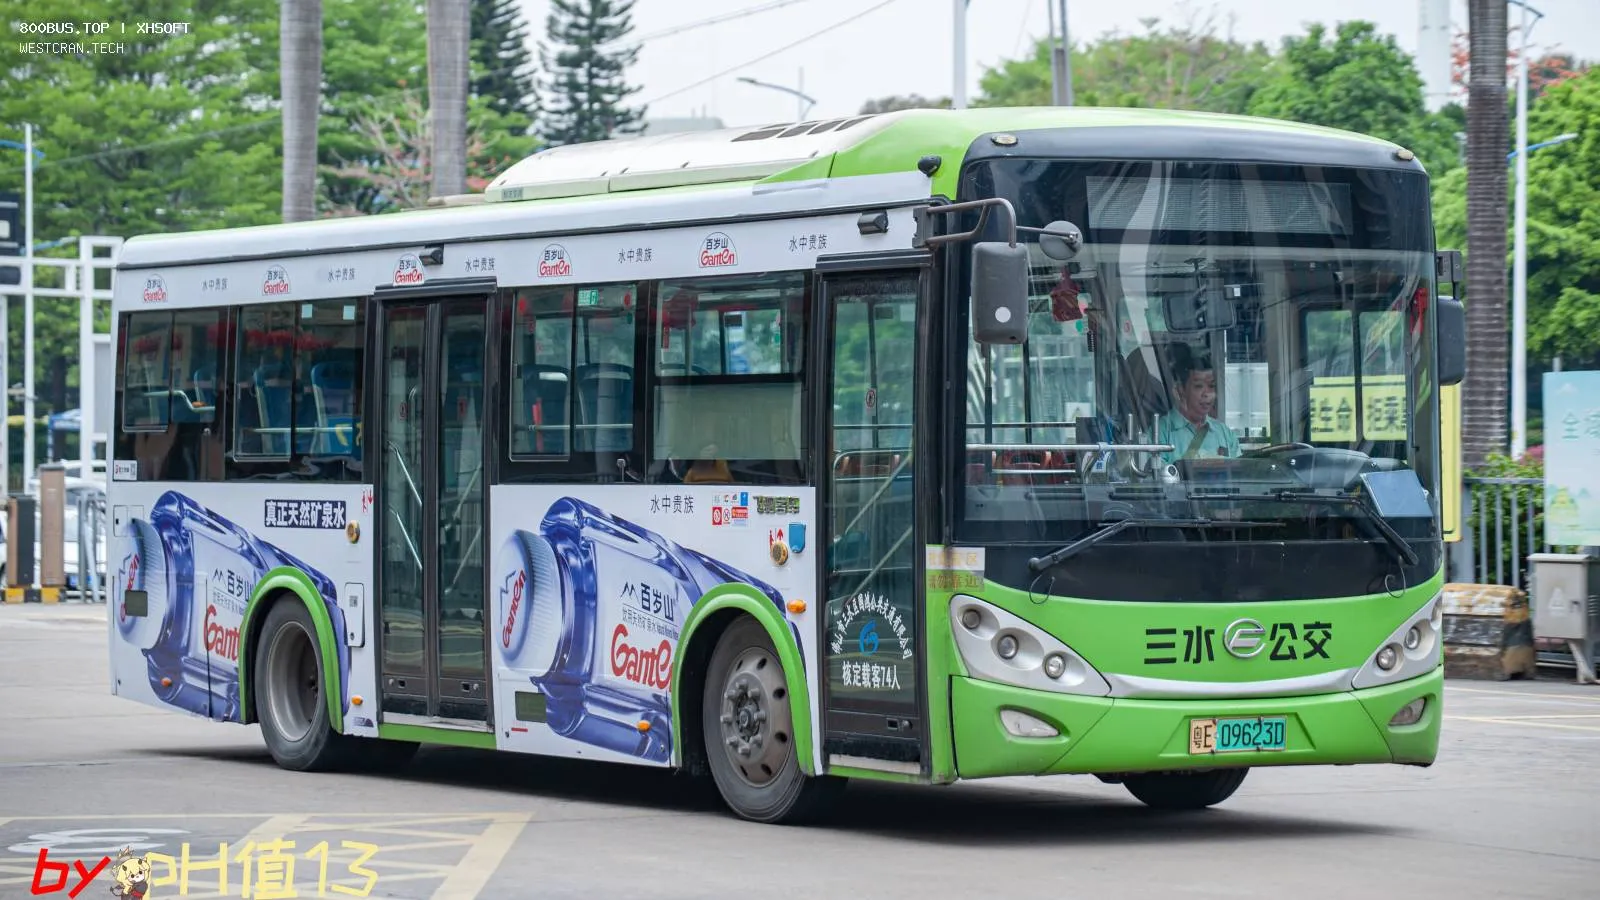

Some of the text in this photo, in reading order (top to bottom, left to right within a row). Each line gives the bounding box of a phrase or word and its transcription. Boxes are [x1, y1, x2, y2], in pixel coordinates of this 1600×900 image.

[706, 238, 729, 250] 百岁山
[788, 234, 828, 252] 水中贵族
[544, 249, 565, 261] 百岁山
[618, 248, 653, 264] 水中贵族
[399, 259, 417, 270] 百岁山
[464, 257, 496, 273] 水中贵族
[267, 270, 284, 281] 百岁山
[327, 267, 356, 282] 水中贵族
[202, 278, 229, 291] 水中贵族
[650, 493, 695, 515] 水中贵族
[265, 501, 345, 528] 真正天然矿泉水
[641, 582, 674, 622] 百岁山
[1144, 621, 1332, 664] 三水 公交
[611, 623, 674, 693] Gante
[842, 660, 901, 690] 核定载客74人
